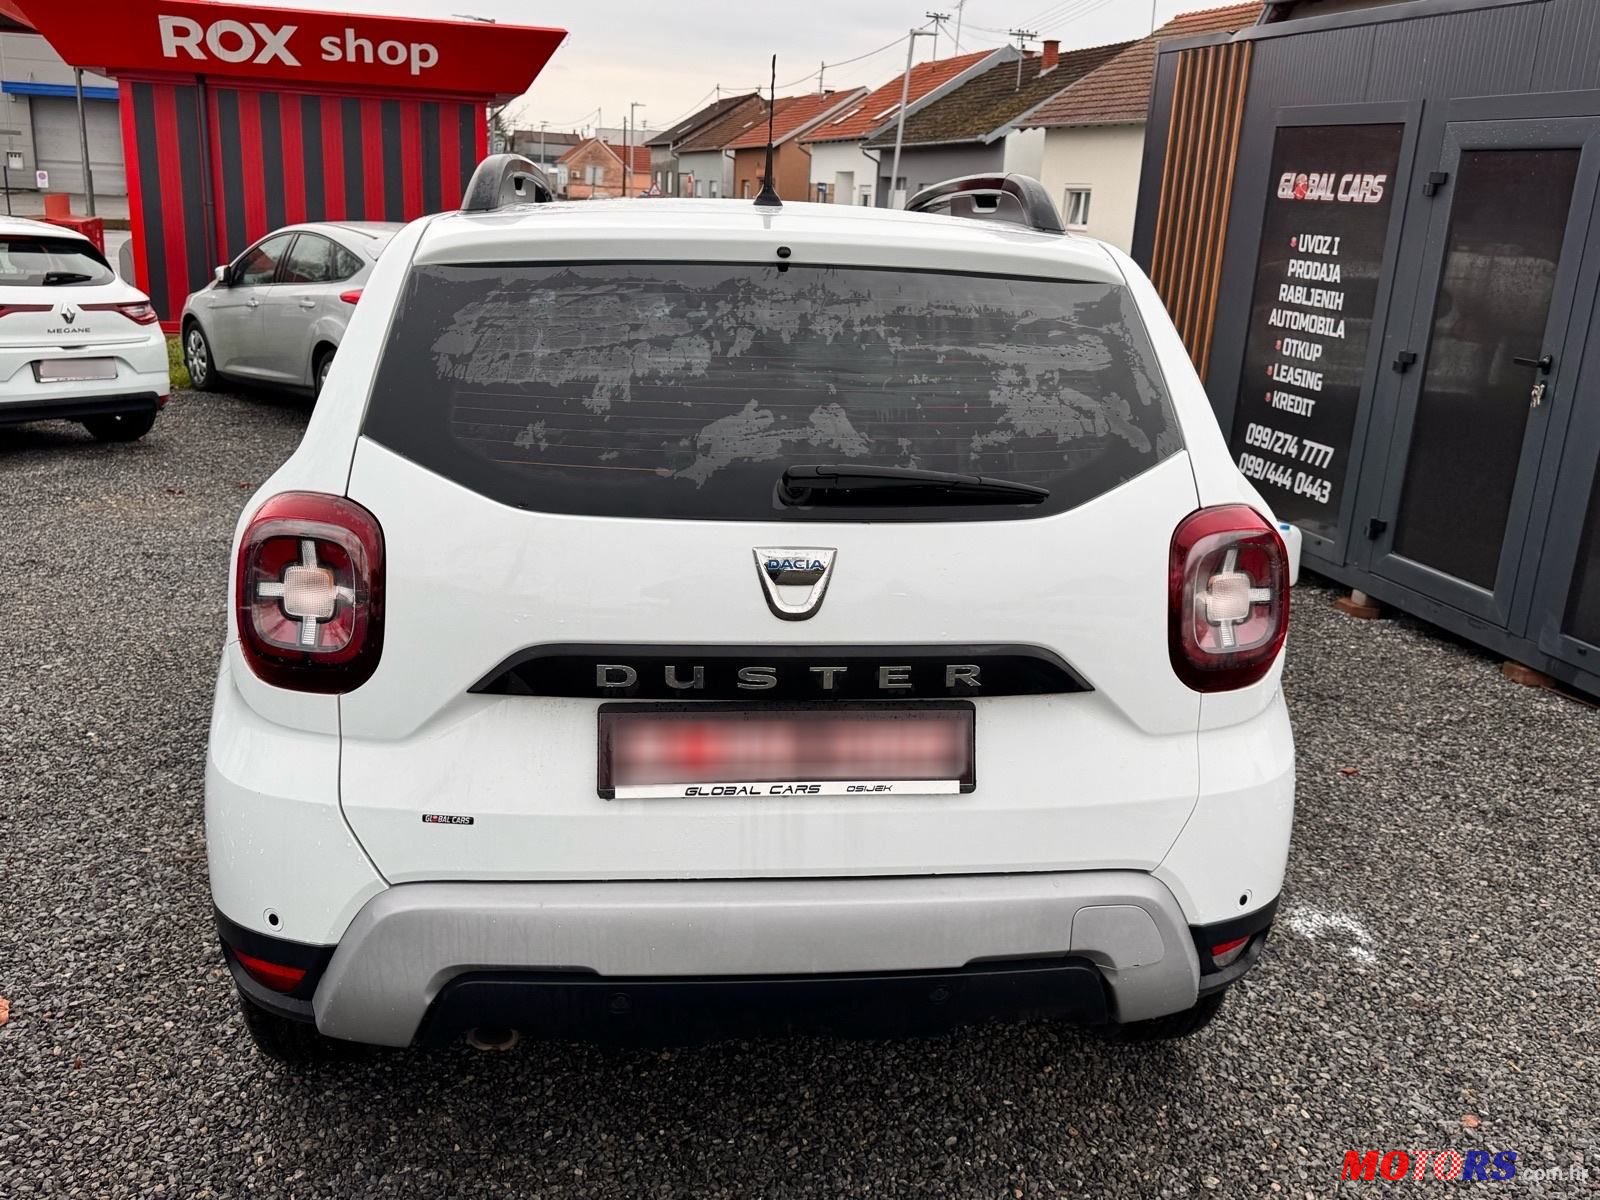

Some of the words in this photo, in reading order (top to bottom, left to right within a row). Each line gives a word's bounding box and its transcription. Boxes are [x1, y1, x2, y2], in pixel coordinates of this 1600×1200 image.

[158, 14, 301, 66] ROX
[320, 28, 440, 76] shop
[1277, 172, 1336, 200] GLOBAL
[1337, 173, 1387, 203] CARS
[1298, 233, 1331, 254] UVOZ
[1331, 236, 1340, 256] I
[1287, 259, 1341, 283] PRODAJA
[1279, 283, 1344, 311] RABLJENIH
[1268, 308, 1345, 339] AUTOMOBILA
[1282, 337, 1322, 362] OTKUP
[1273, 364, 1323, 391] LEASING
[1272, 390, 1316, 417] KREDIT
[1245, 422, 1299, 459] 099/274
[1300, 439, 1335, 469] 7777
[1238, 452, 1293, 490] 099/444
[1293, 471, 1332, 504] 0443
[767, 558, 824, 571] DACIA
[596, 664, 982, 690] DUSTER
[684, 785, 761, 796] GLOBAL
[769, 784, 821, 795] CARS
[846, 785, 893, 793] OSIJEK
[451, 816, 470, 824] CARS
